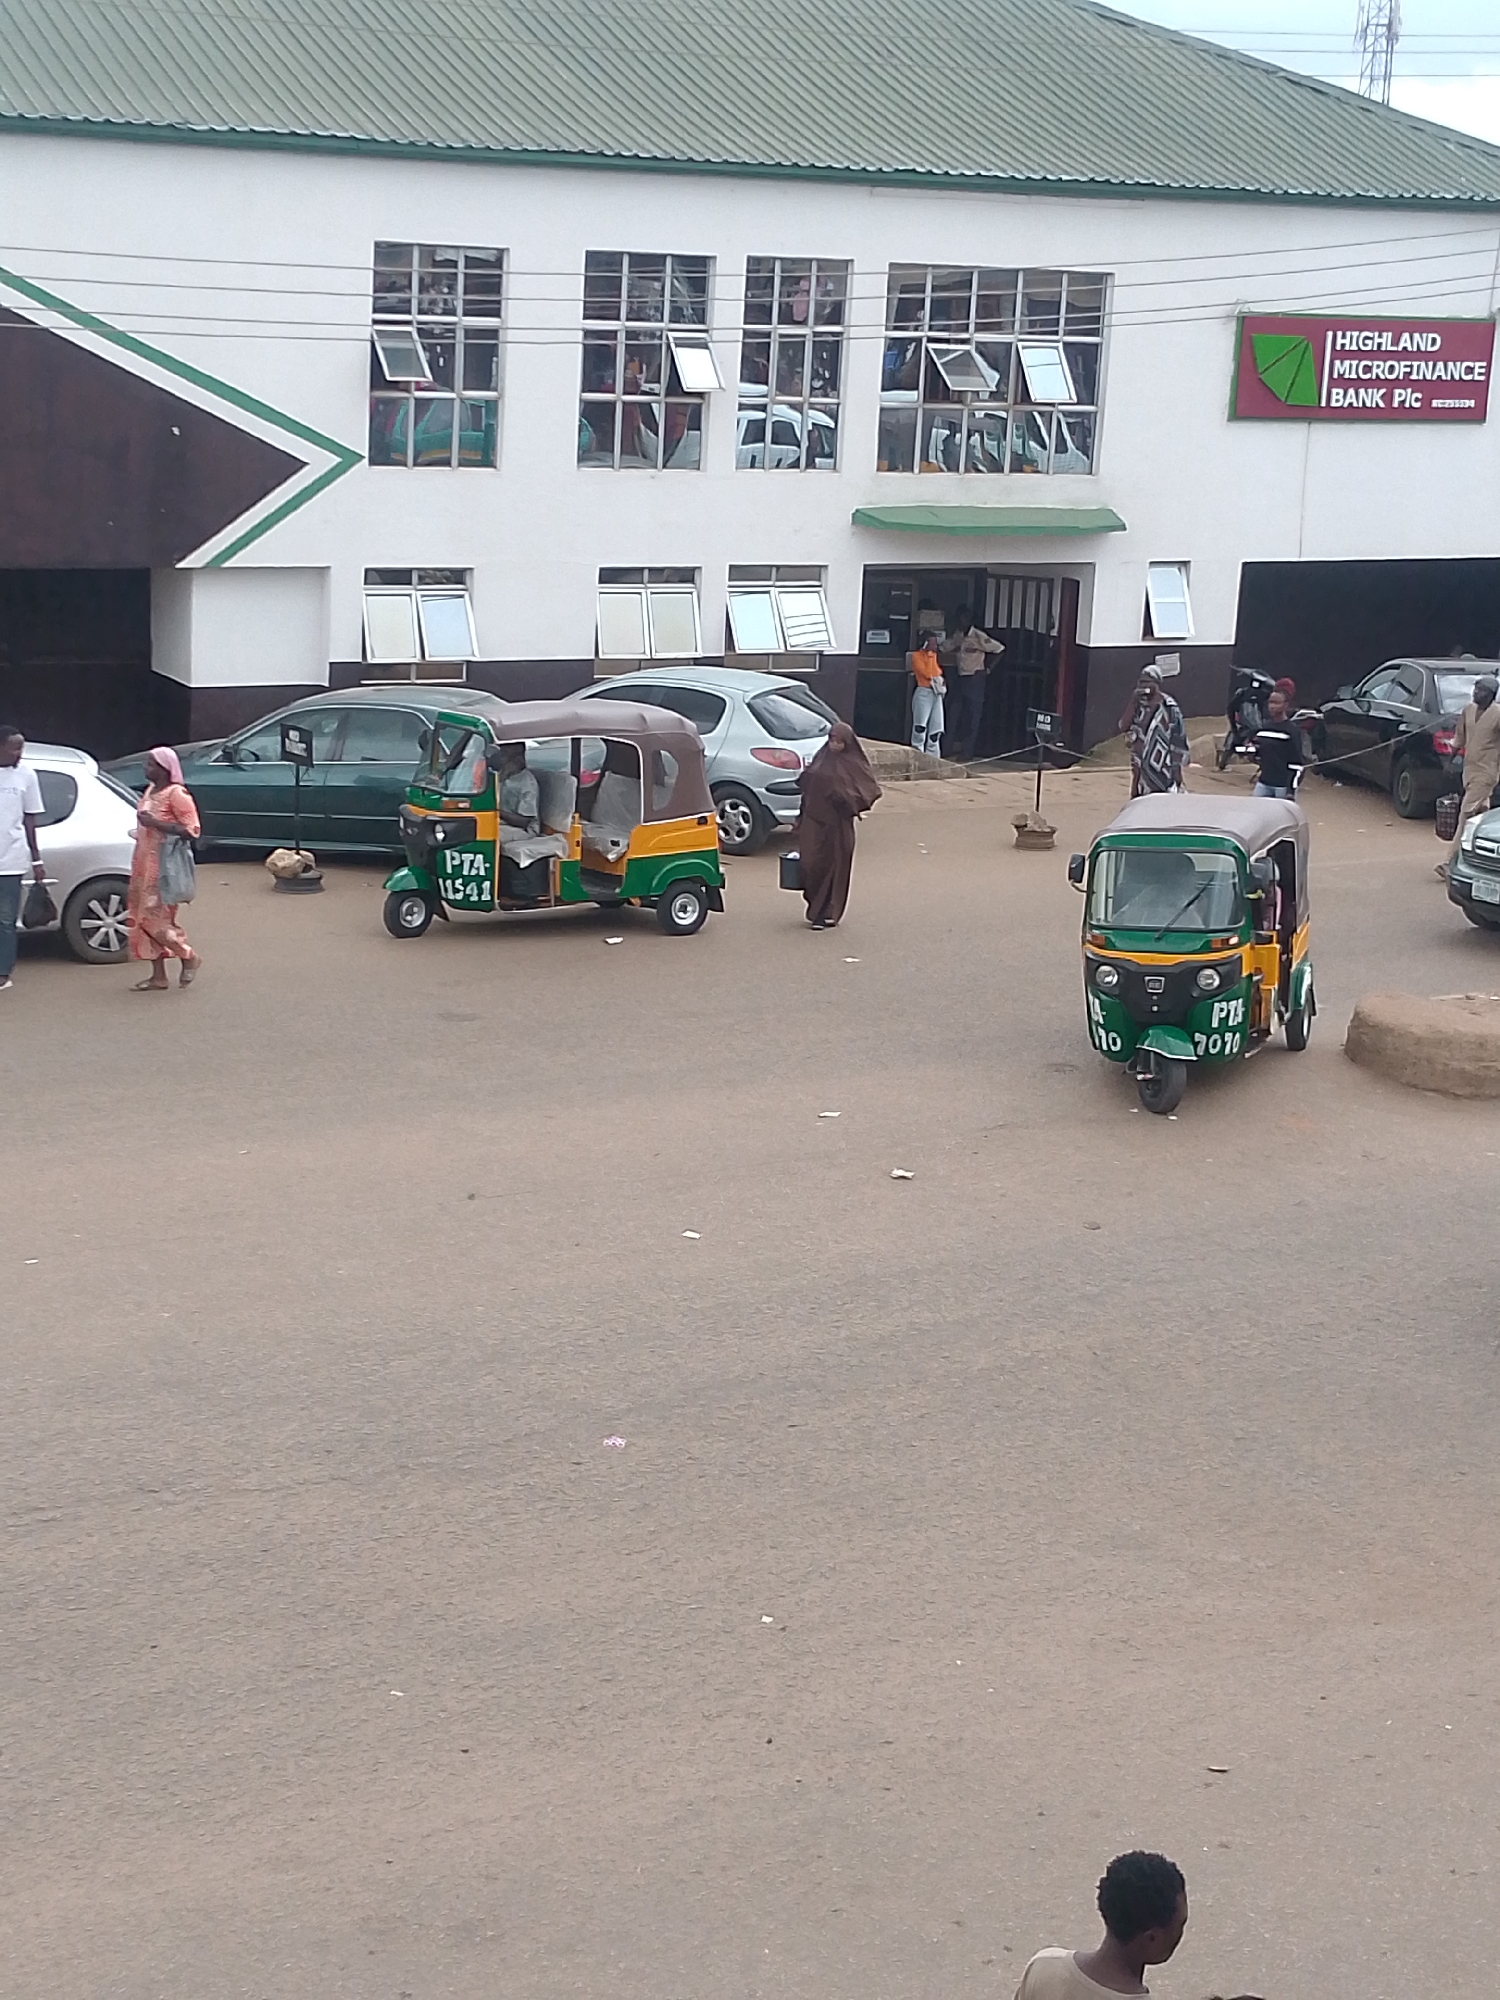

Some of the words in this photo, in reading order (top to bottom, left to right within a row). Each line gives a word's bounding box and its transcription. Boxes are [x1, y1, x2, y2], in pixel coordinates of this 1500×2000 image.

[1335, 331, 1442, 352] HIGHLAND
[1332, 359, 1487, 381] MICROFINANCE
[1330, 387, 1386, 408] BANK
[1391, 387, 1422, 408] Plc
[437, 877, 492, 902] 11541
[1194, 1031, 1240, 1056] 7070
